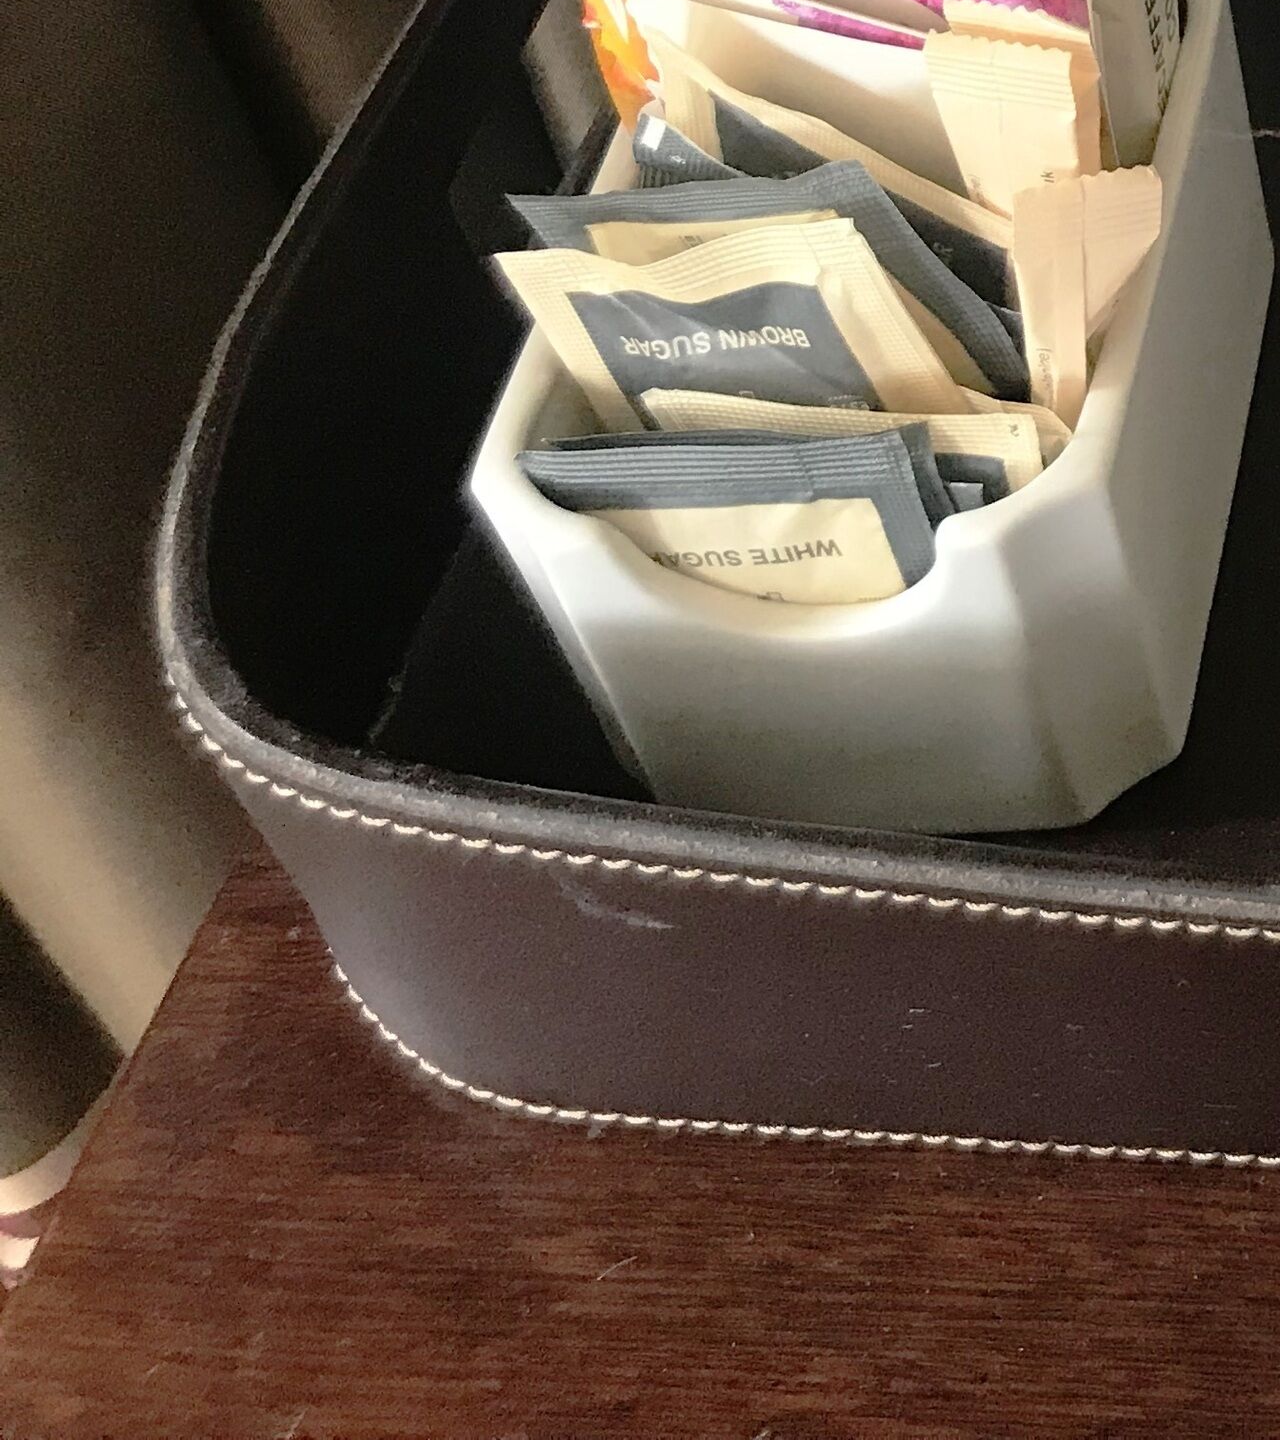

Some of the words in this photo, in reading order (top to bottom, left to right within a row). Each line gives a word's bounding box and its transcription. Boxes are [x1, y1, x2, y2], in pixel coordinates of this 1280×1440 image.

[620, 331, 711, 360] SUGAR
[719, 325, 811, 350] BROWN
[748, 538, 843, 566] WHITE
